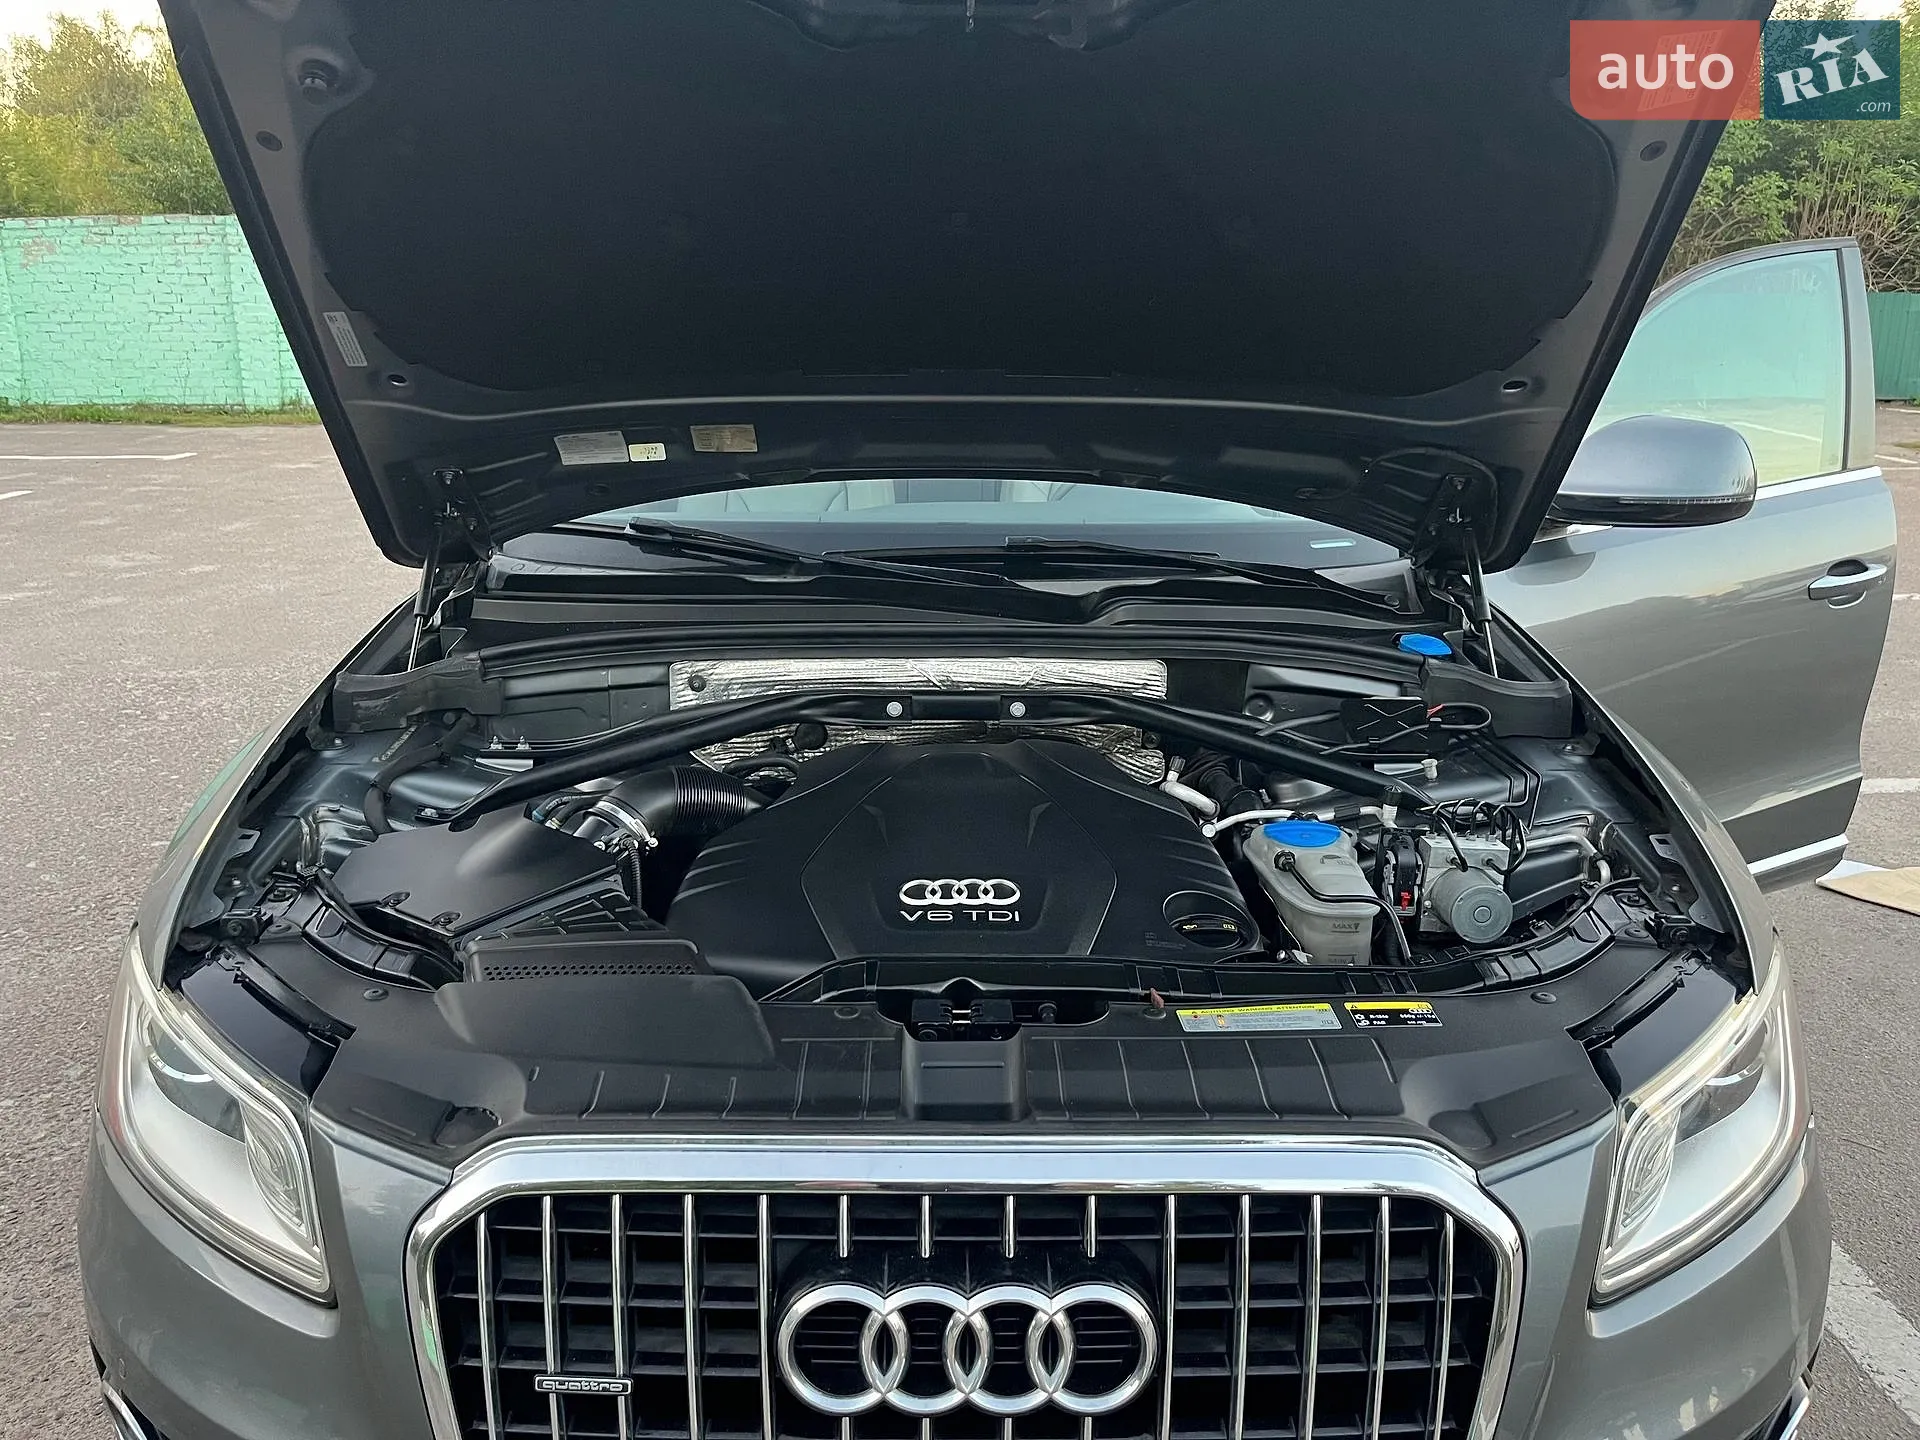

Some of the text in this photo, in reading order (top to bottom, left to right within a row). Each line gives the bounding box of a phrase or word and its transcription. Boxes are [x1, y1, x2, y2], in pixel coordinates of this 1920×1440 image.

[900, 910, 1020, 921] V6 TDI
[542, 1380, 623, 1391] quattro
